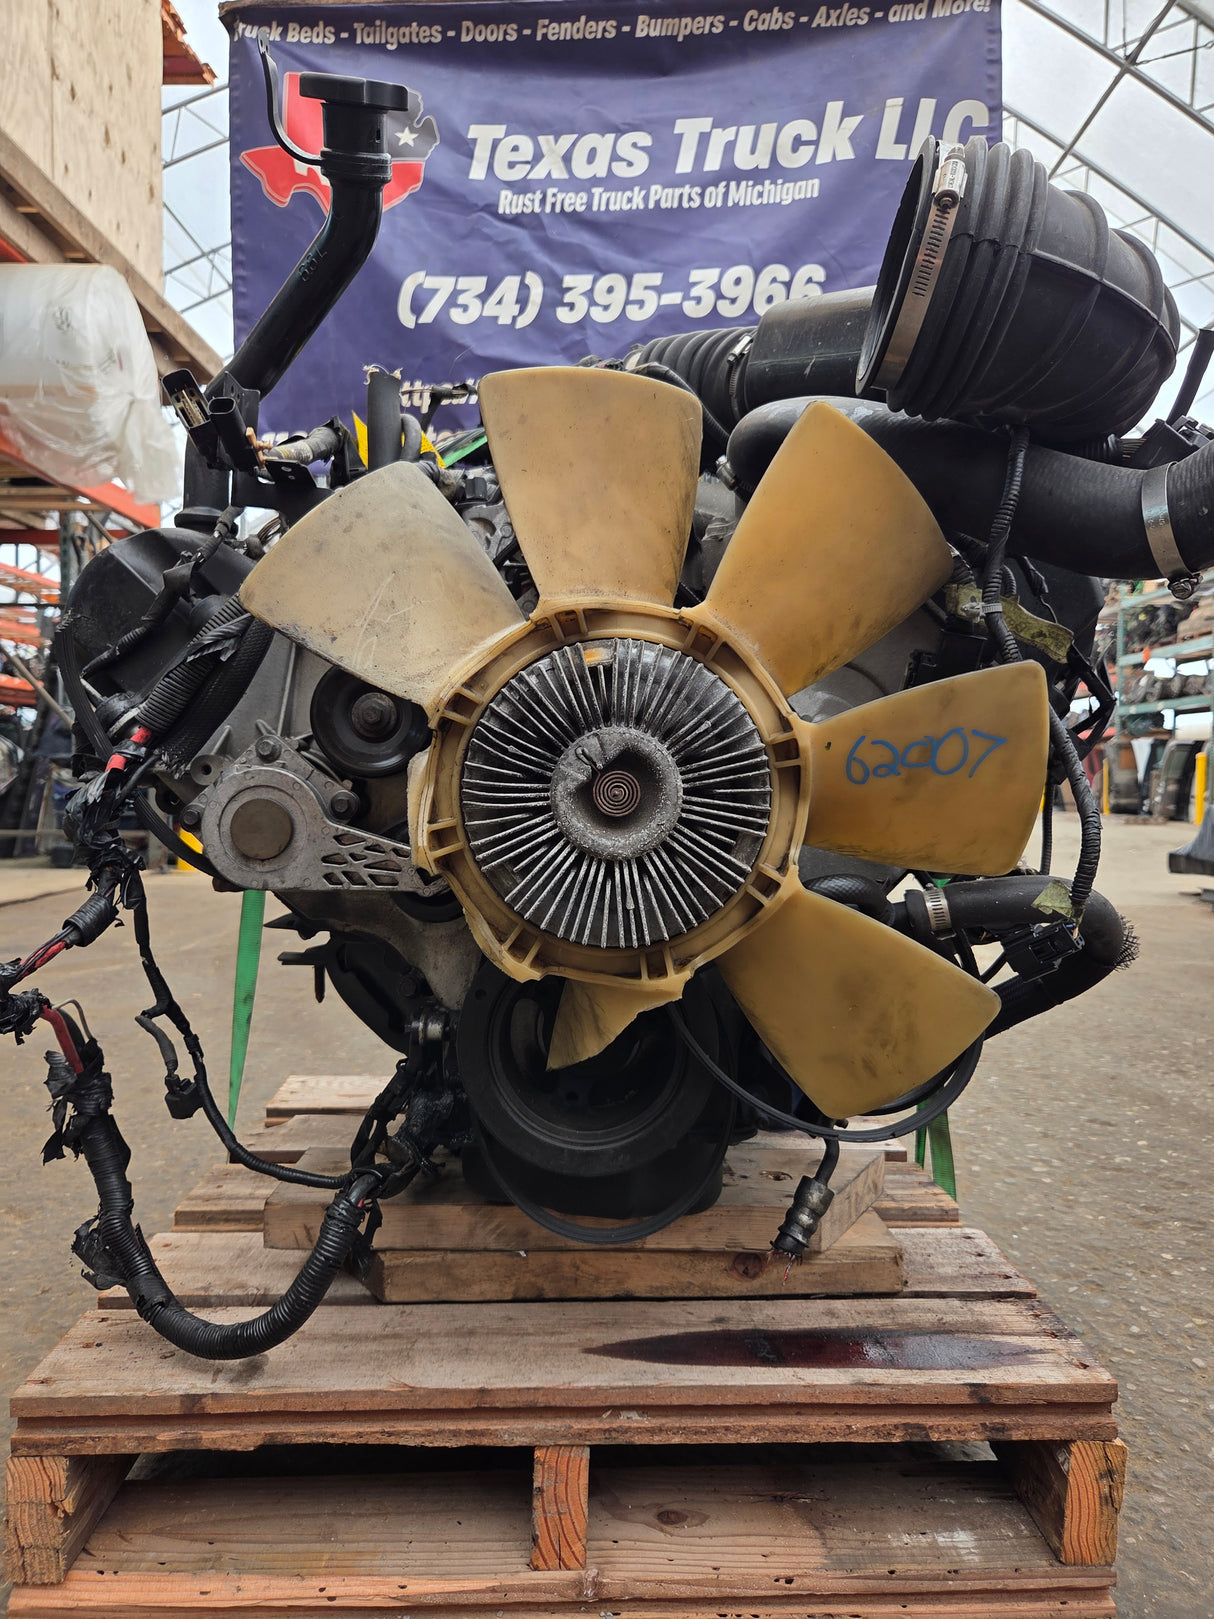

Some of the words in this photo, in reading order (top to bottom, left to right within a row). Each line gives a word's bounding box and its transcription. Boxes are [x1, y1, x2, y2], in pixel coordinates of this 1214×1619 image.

[286, 20, 336, 44] Beds
[353, 20, 442, 50] Tailgates
[460, 20, 518, 42] Doors
[535, 15, 617, 41] Fenders
[635, 15, 725, 42] Bumpers
[743, 6, 795, 32] Cabs
[811, 3, 870, 28] Axles
[888, 0, 930, 23] and
[467, 124, 653, 182] Texas
[673, 100, 865, 175] Truck
[497, 188, 541, 214] Rust
[545, 187, 587, 214] Free
[591, 186, 645, 212] Truck
[648, 184, 701, 209] Parts
[703, 181, 727, 207] of
[727, 178, 820, 208] Michigan
[396, 270, 544, 330] (734)
[556, 264, 827, 324] 395-3966
[846, 727, 1008, 785] 62007
